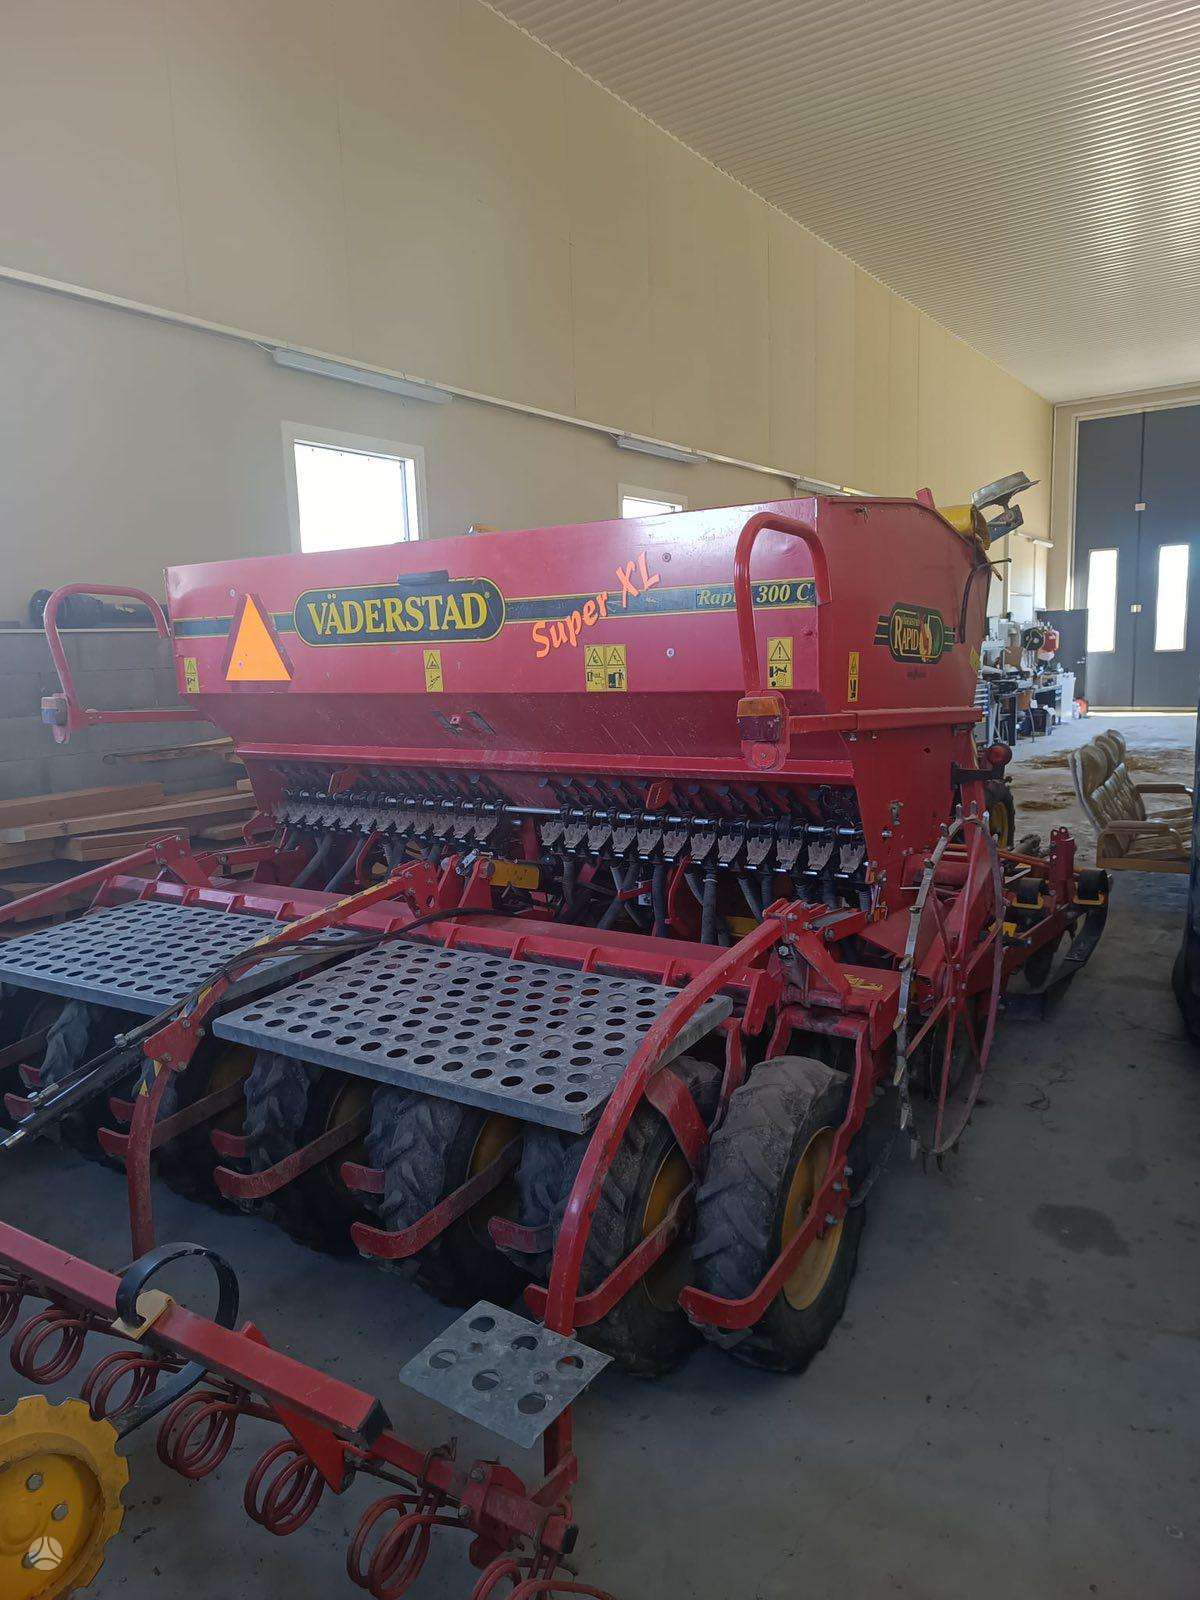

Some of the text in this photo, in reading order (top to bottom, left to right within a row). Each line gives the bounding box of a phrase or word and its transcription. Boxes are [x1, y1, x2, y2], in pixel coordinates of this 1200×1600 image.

[307, 592, 488, 635] VÄDERSTAD
[532, 551, 660, 658] Super XL
[756, 584, 791, 603] 300
[894, 615, 919, 653] RAPID
